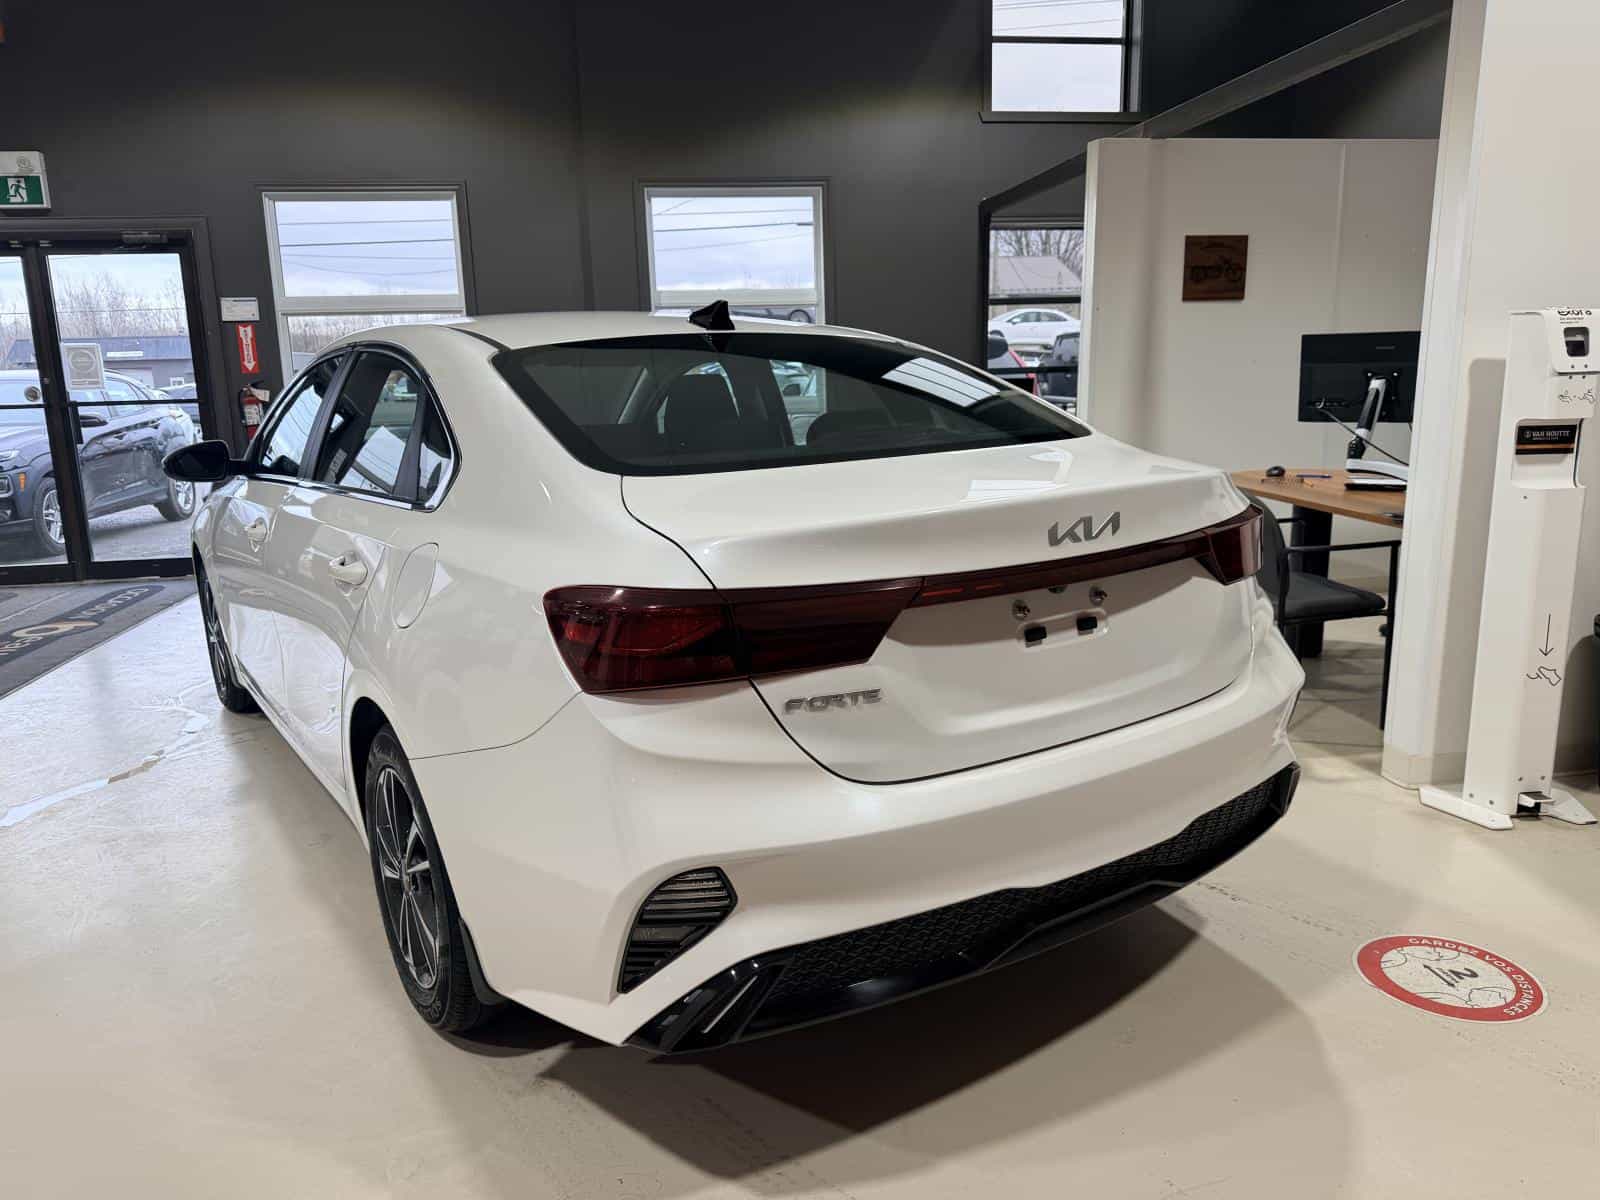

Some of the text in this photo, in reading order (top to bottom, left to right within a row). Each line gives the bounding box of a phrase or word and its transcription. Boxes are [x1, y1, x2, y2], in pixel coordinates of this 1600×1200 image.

[1048, 511, 1121, 547] KIA
[785, 688, 882, 714] FORTE
[1408, 938, 1537, 1016] GARDEZ VOS DISTANCES
